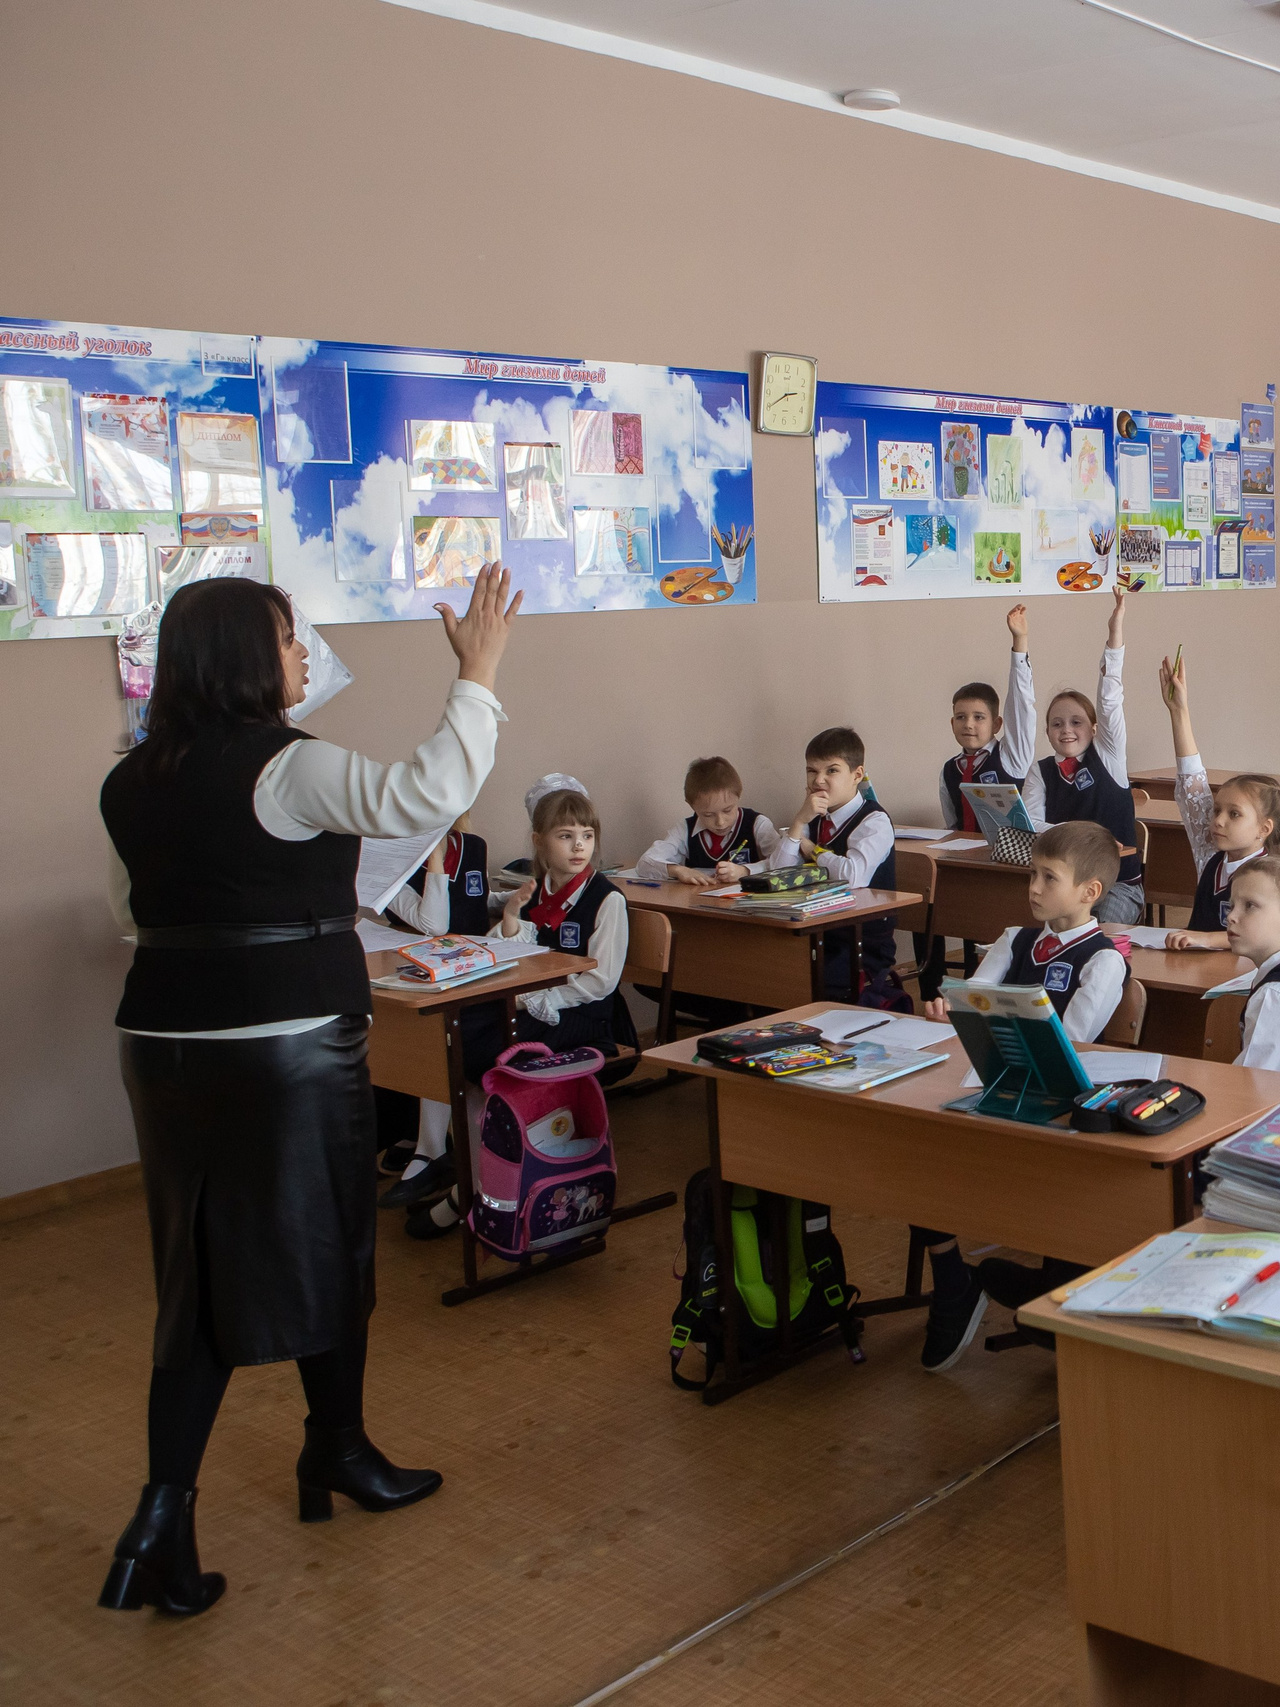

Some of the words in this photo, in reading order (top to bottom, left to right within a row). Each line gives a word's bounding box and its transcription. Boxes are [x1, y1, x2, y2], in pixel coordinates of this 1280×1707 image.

[0, 331, 80, 351] ассный
[82, 337, 153, 358] уголок
[204, 352, 209, 360] 3
[227, 355, 249, 364] класс
[462, 358, 499, 380] Мир
[501, 364, 560, 380] глазами
[562, 364, 607, 383] детей
[775, 364, 780, 374] 11
[784, 364, 791, 374] 12
[796, 367, 799, 376] 1
[766, 375, 774, 384] 10
[801, 378, 806, 388] 2
[766, 388, 771, 397] 9
[801, 392, 806, 401] 3
[799, 406, 804, 414] 4
[934, 395, 957, 413] Мир
[958, 400, 995, 413] глазами
[996, 400, 1023, 415] детей
[772, 413, 777, 424] 7
[781, 416, 787, 426] 6
[792, 416, 797, 425] 5
[197, 431, 242, 441] ДИПЛОМ
